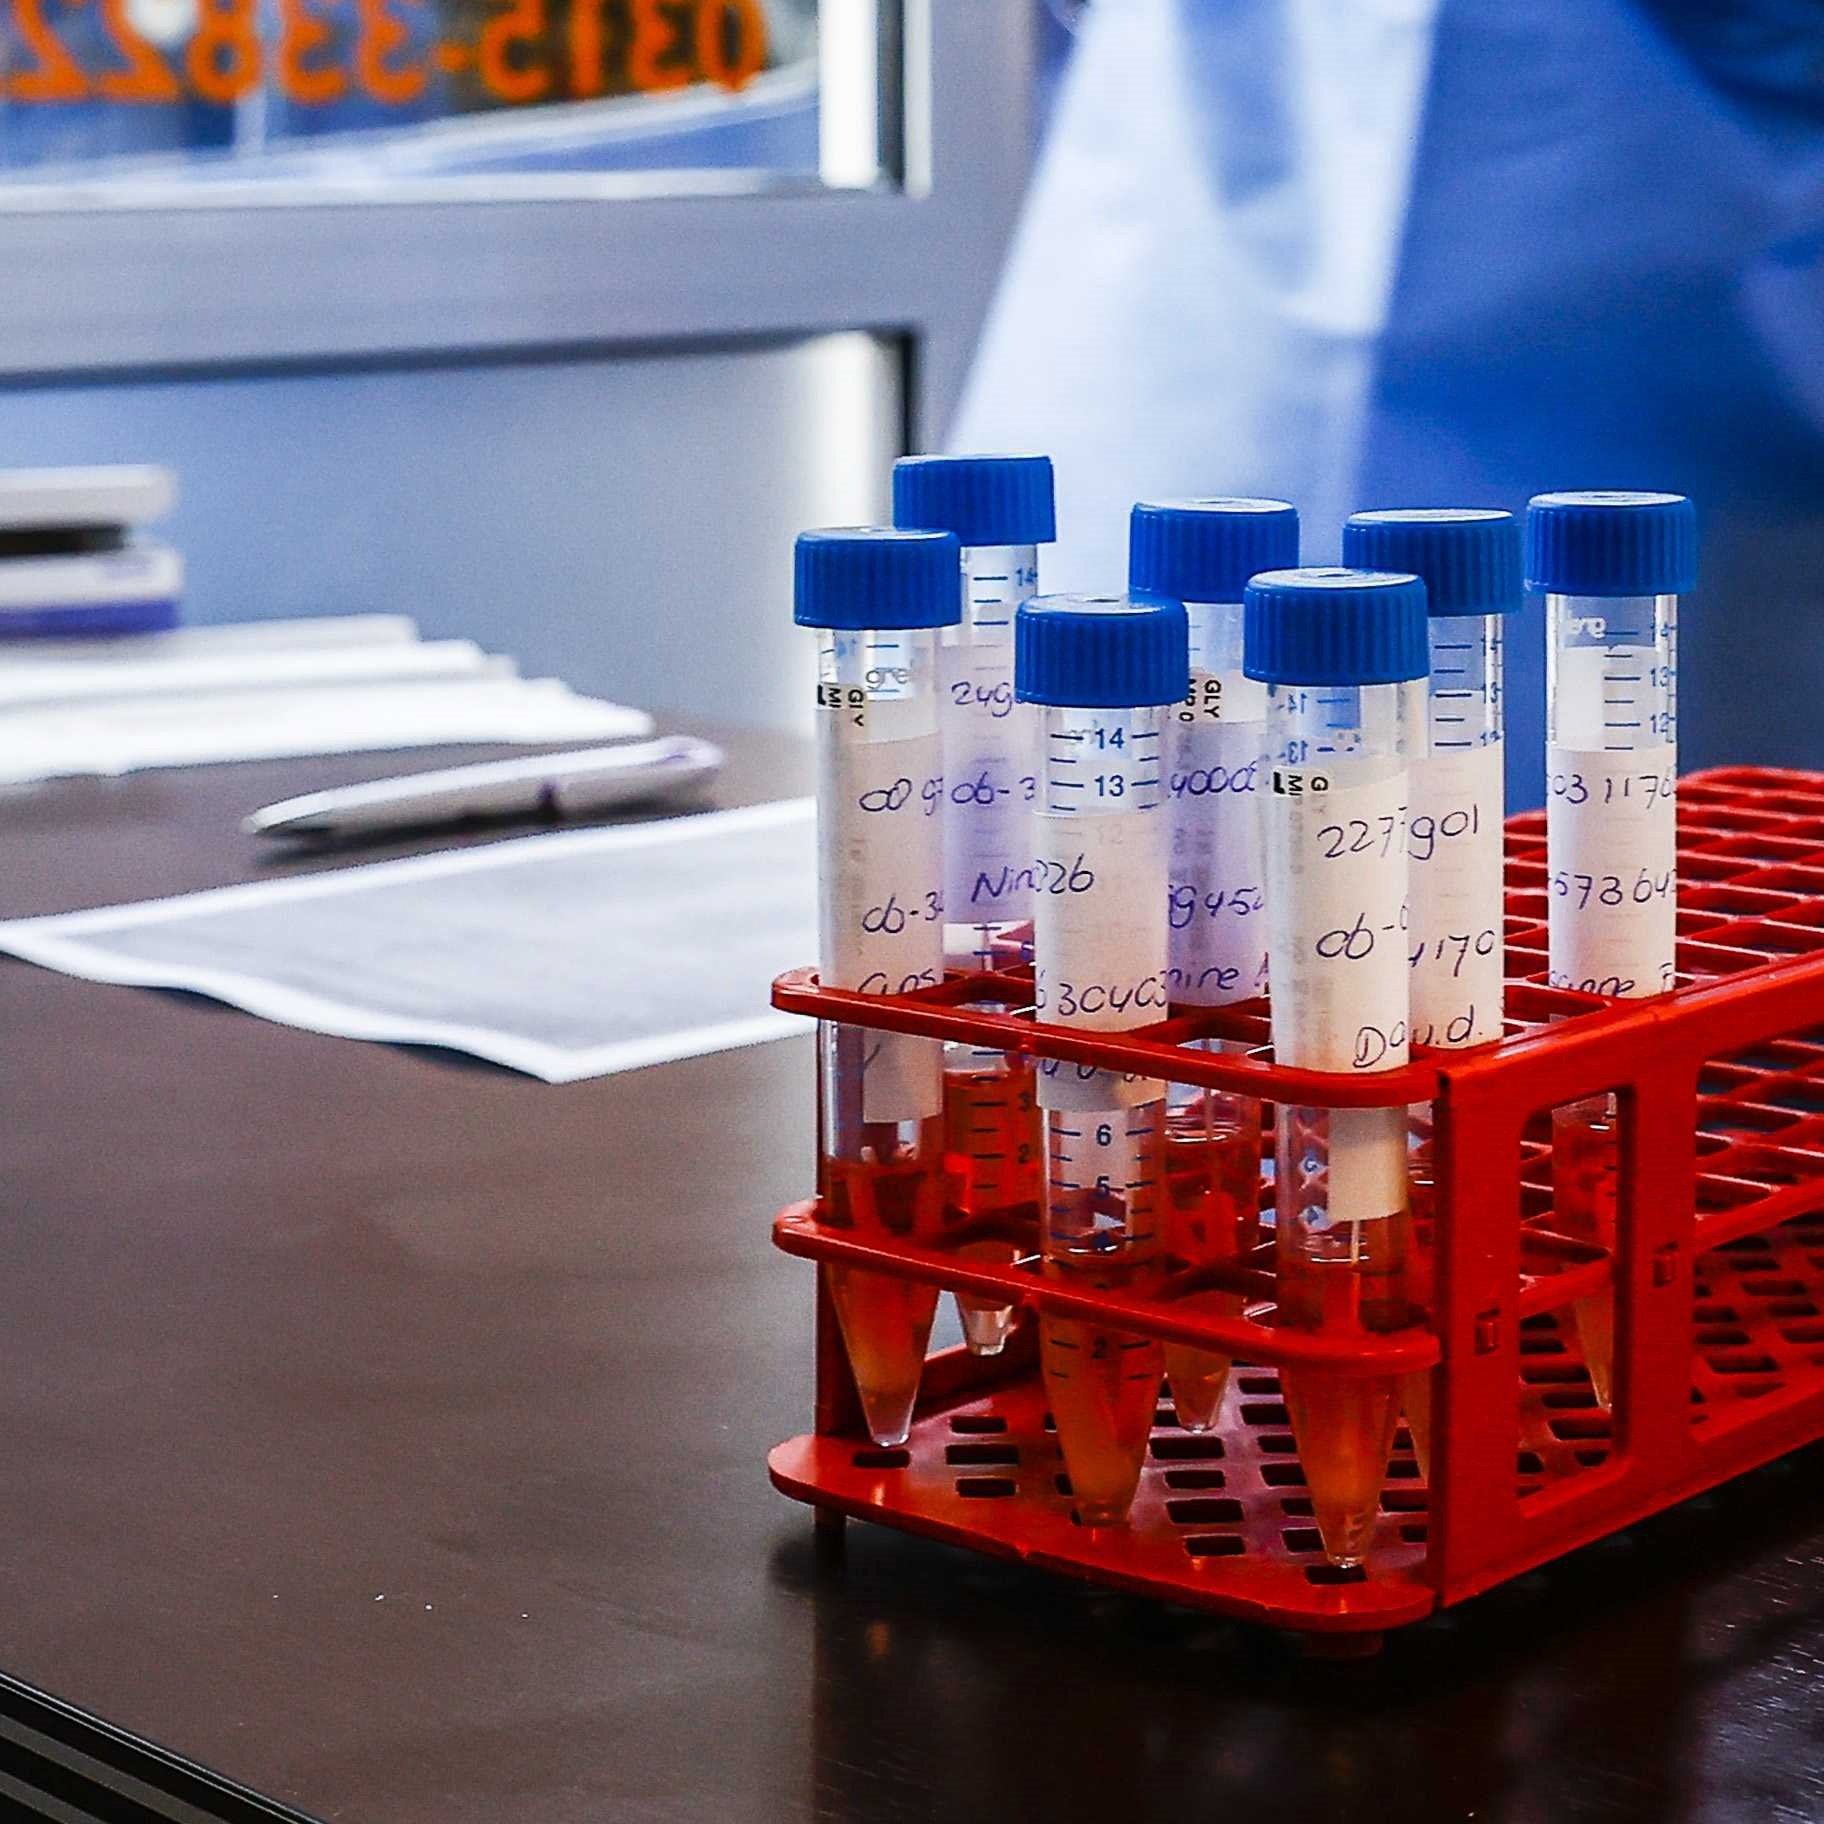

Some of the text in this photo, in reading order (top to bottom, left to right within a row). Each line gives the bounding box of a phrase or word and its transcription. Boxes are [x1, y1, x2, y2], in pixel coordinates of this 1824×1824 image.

[1095, 727, 1125, 750] 14
[1094, 774, 1125, 798] 13
[1096, 1124, 1112, 1146] 6
